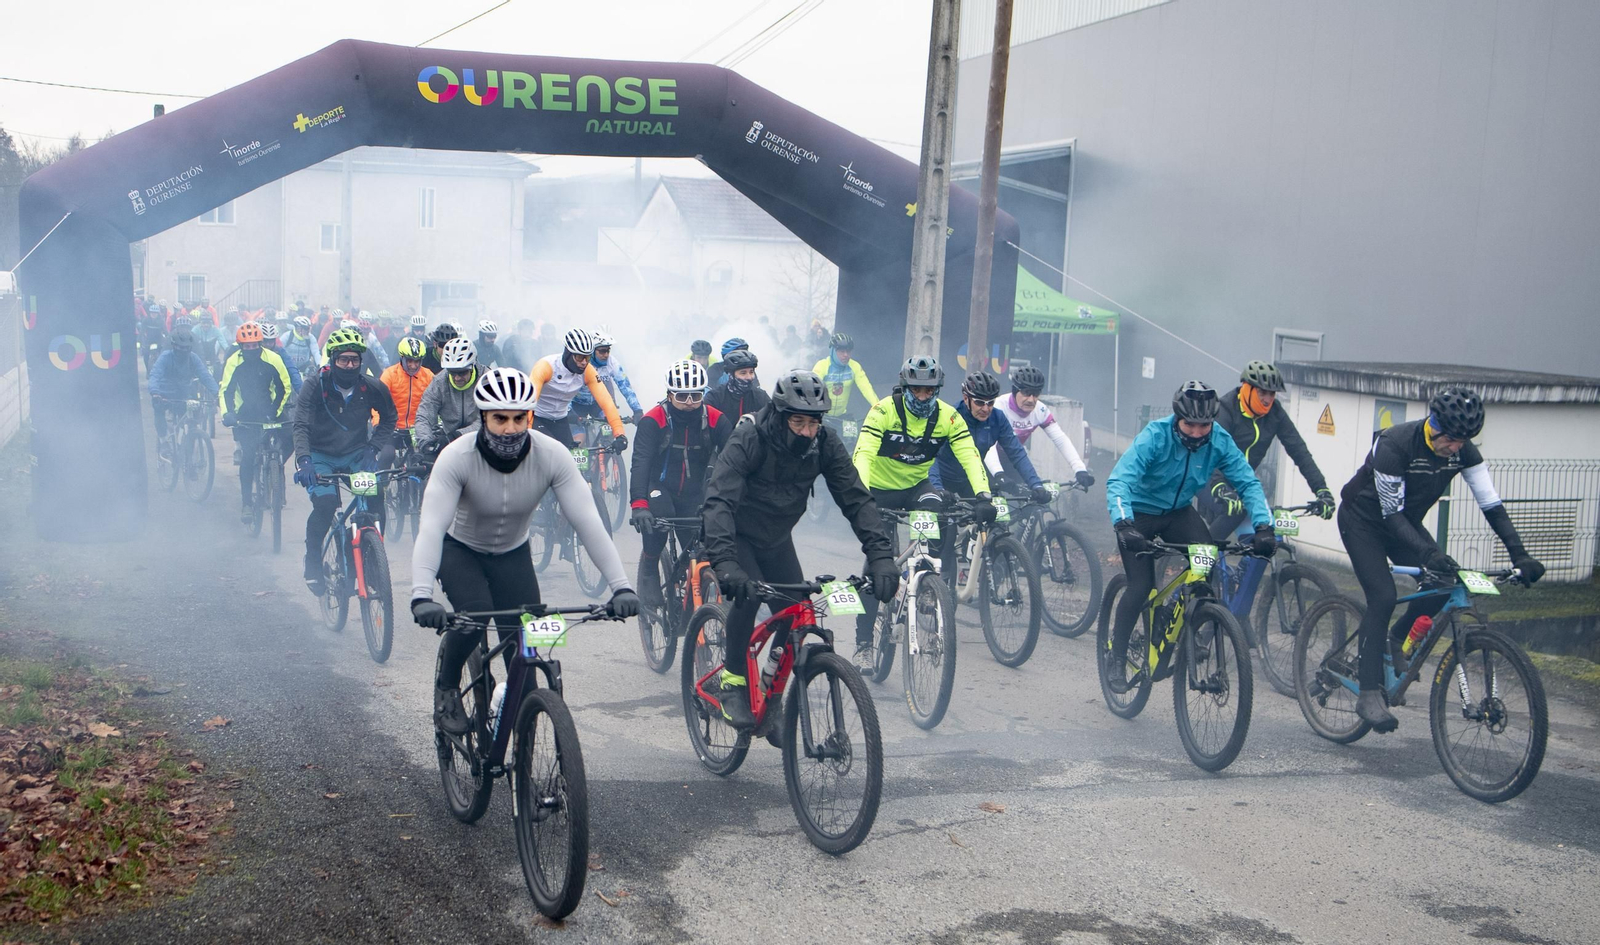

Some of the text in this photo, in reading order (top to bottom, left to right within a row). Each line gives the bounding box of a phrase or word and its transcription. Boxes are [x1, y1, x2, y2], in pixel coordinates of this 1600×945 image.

[417, 65, 679, 115] OURENSE
[308, 105, 345, 128] DEPORTE
[585, 118, 676, 136] NATURAL
[233, 139, 261, 158] inorde
[258, 142, 281, 157] Ourense
[760, 140, 802, 165] OURENSE
[765, 130, 820, 164] DEPUTACIÓN
[145, 164, 203, 198] DEPUTACIÓN
[846, 173, 874, 192] inorde
[149, 181, 192, 207] OURENSE
[49, 332, 121, 371] OU
[353, 480, 375, 488] 046
[914, 521, 935, 530] 087
[1276, 519, 1297, 528] 039
[1467, 579, 1491, 587] 033
[831, 593, 856, 604] 168
[529, 621, 561, 633] 145
